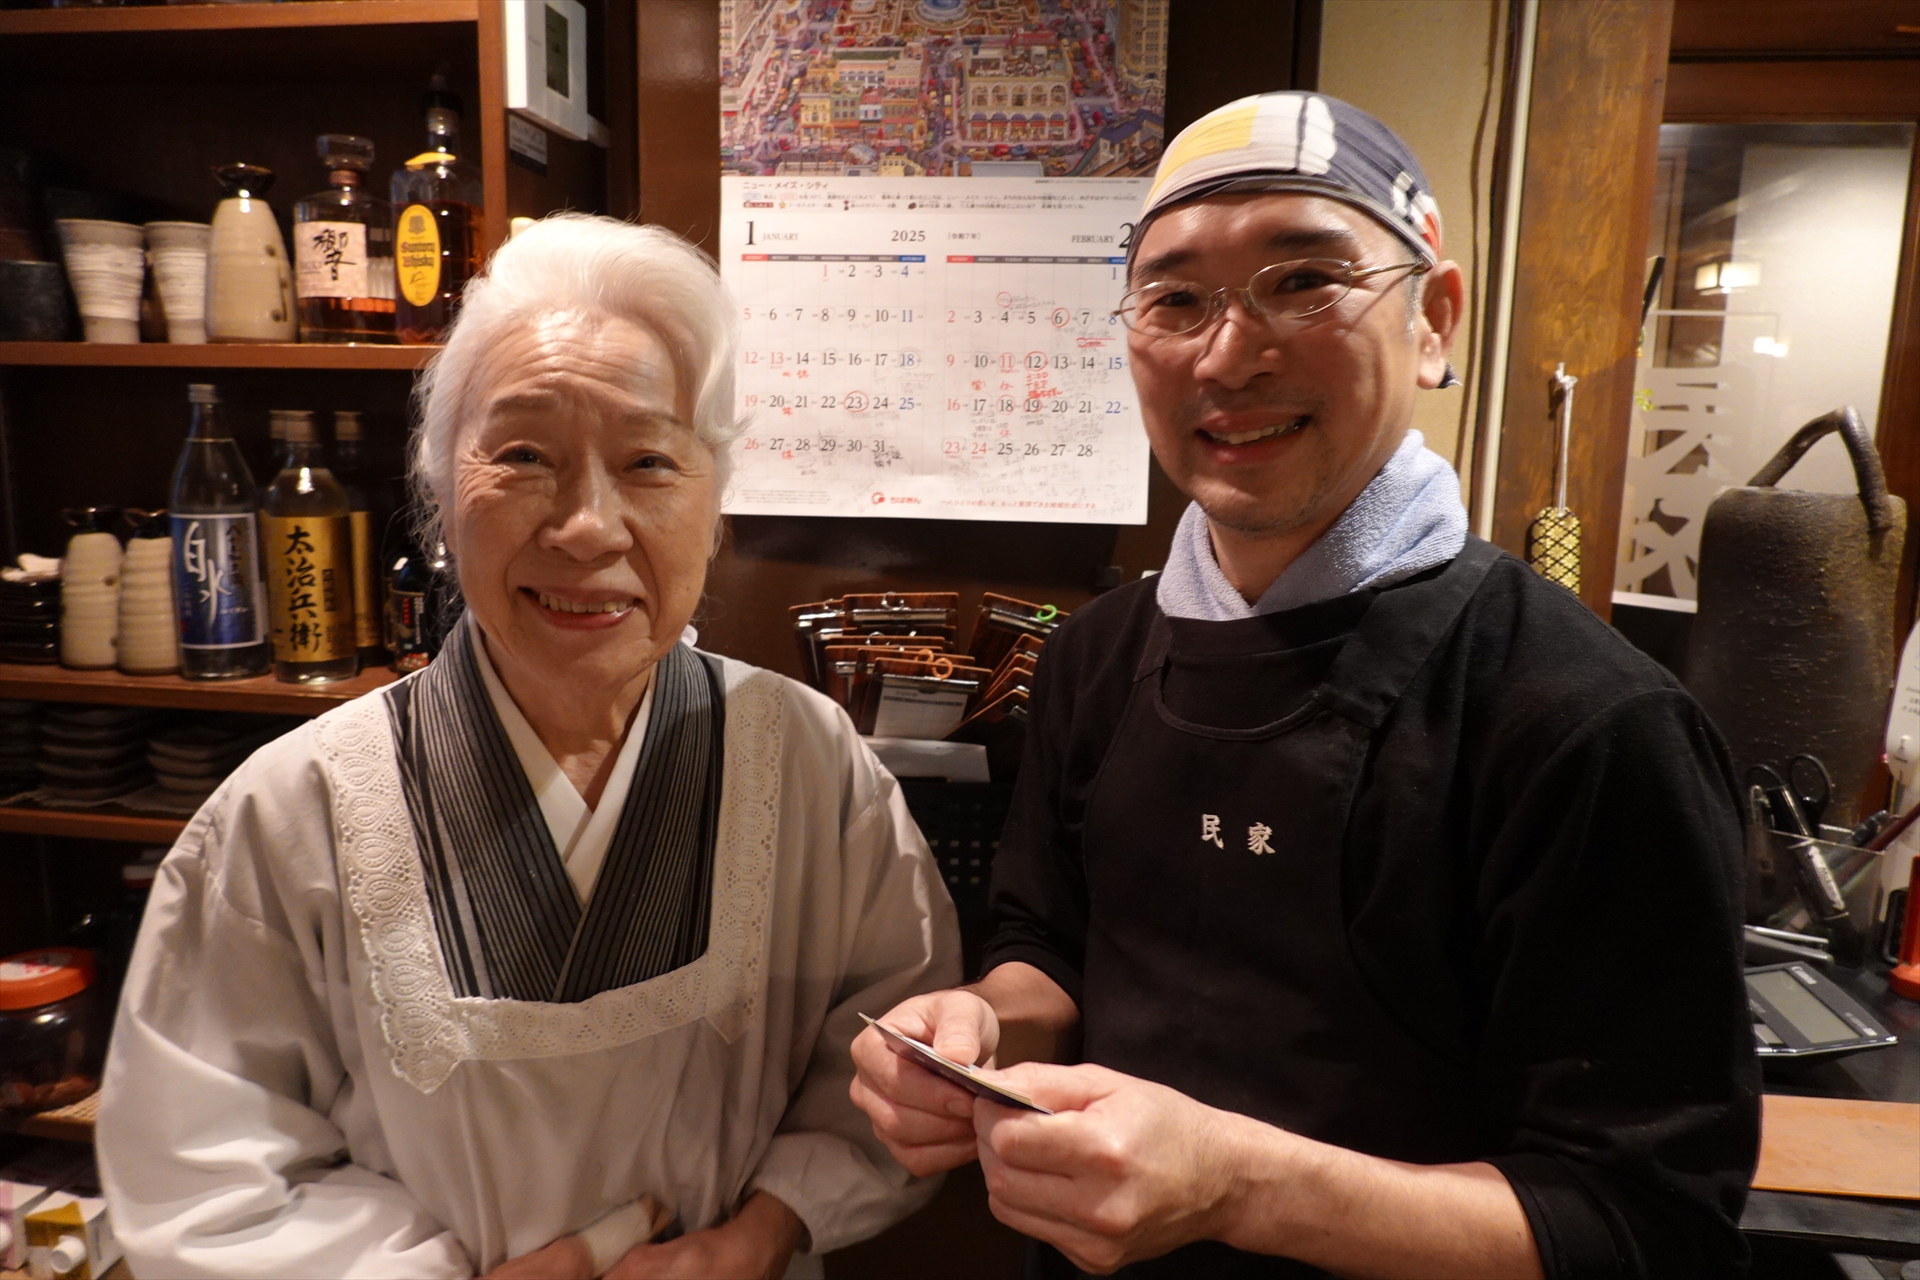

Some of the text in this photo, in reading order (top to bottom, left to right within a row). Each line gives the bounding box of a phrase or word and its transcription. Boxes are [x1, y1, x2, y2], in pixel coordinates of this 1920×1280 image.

[743, 181, 829, 191] ニュー・メイズ・シティ
[744, 220, 799, 246] 1 JANUARY
[891, 229, 926, 242] 2025
[1071, 221, 1135, 249] FEBRUARY 2
[401, 241, 436, 255] Suntory
[402, 254, 434, 269] Whisky
[822, 265, 909, 278] 1 2 3 4
[1111, 267, 1118, 280] 1
[743, 308, 914, 323] 5 6 7 8 9 10 11
[947, 310, 956, 323] 2
[973, 310, 983, 324] 3
[1000, 311, 1010, 324] 4
[1027, 311, 1036, 324] 5
[1054, 311, 1063, 325] 6
[1081, 312, 1090, 325] 7
[744, 351, 915, 367] 12 13 14 15 16 17 18
[946, 354, 1123, 370] 9 10 11 12 13 14 15
[744, 394, 915, 410] 19 20 21 22 23 24 25
[946, 398, 1121, 415] 16 17 18 19 20 21 22
[744, 437, 886, 453] 26 27 28 29 30 31
[944, 441, 1093, 457] 23 24 25 26 27 28
[284, 525, 323, 653] 太治兵衛
[1201, 813, 1276, 856] 民家
